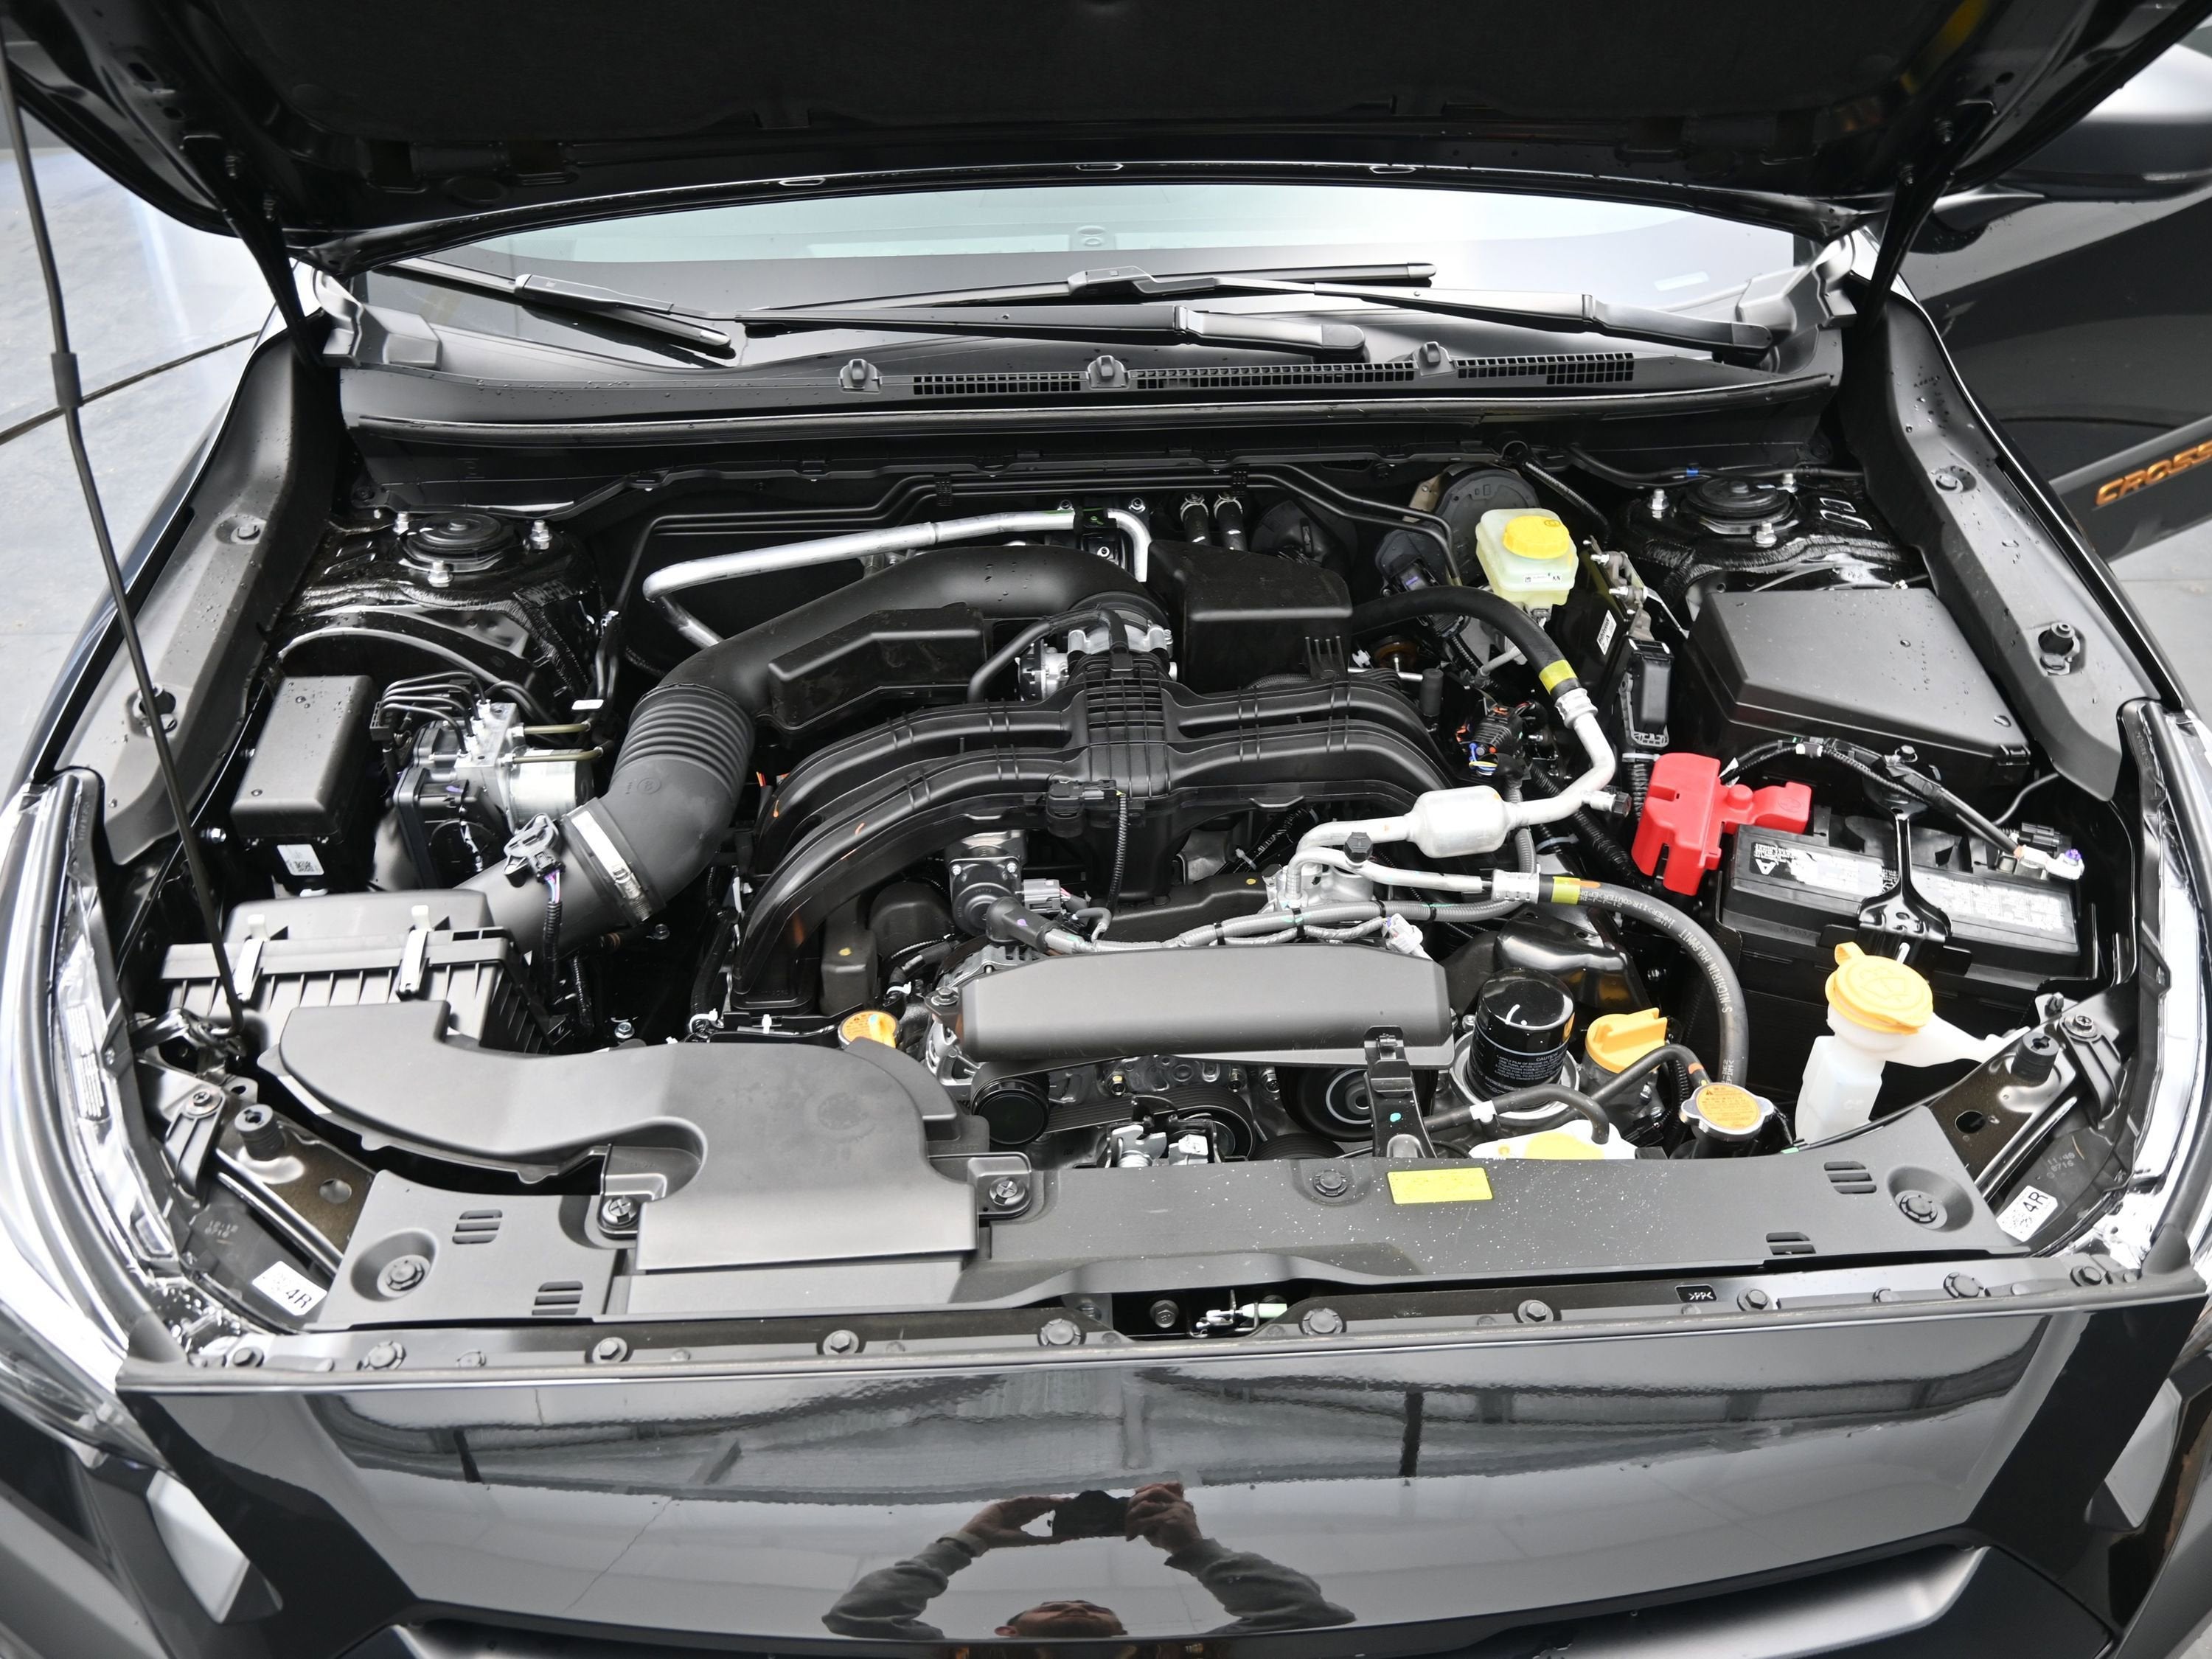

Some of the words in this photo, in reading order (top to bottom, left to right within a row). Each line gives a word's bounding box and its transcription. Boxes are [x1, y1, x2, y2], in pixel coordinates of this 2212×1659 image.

[2096, 440, 2212, 507] CROSS
[2023, 1192, 2049, 1212] 4R
[285, 1289, 313, 1309] 4R
